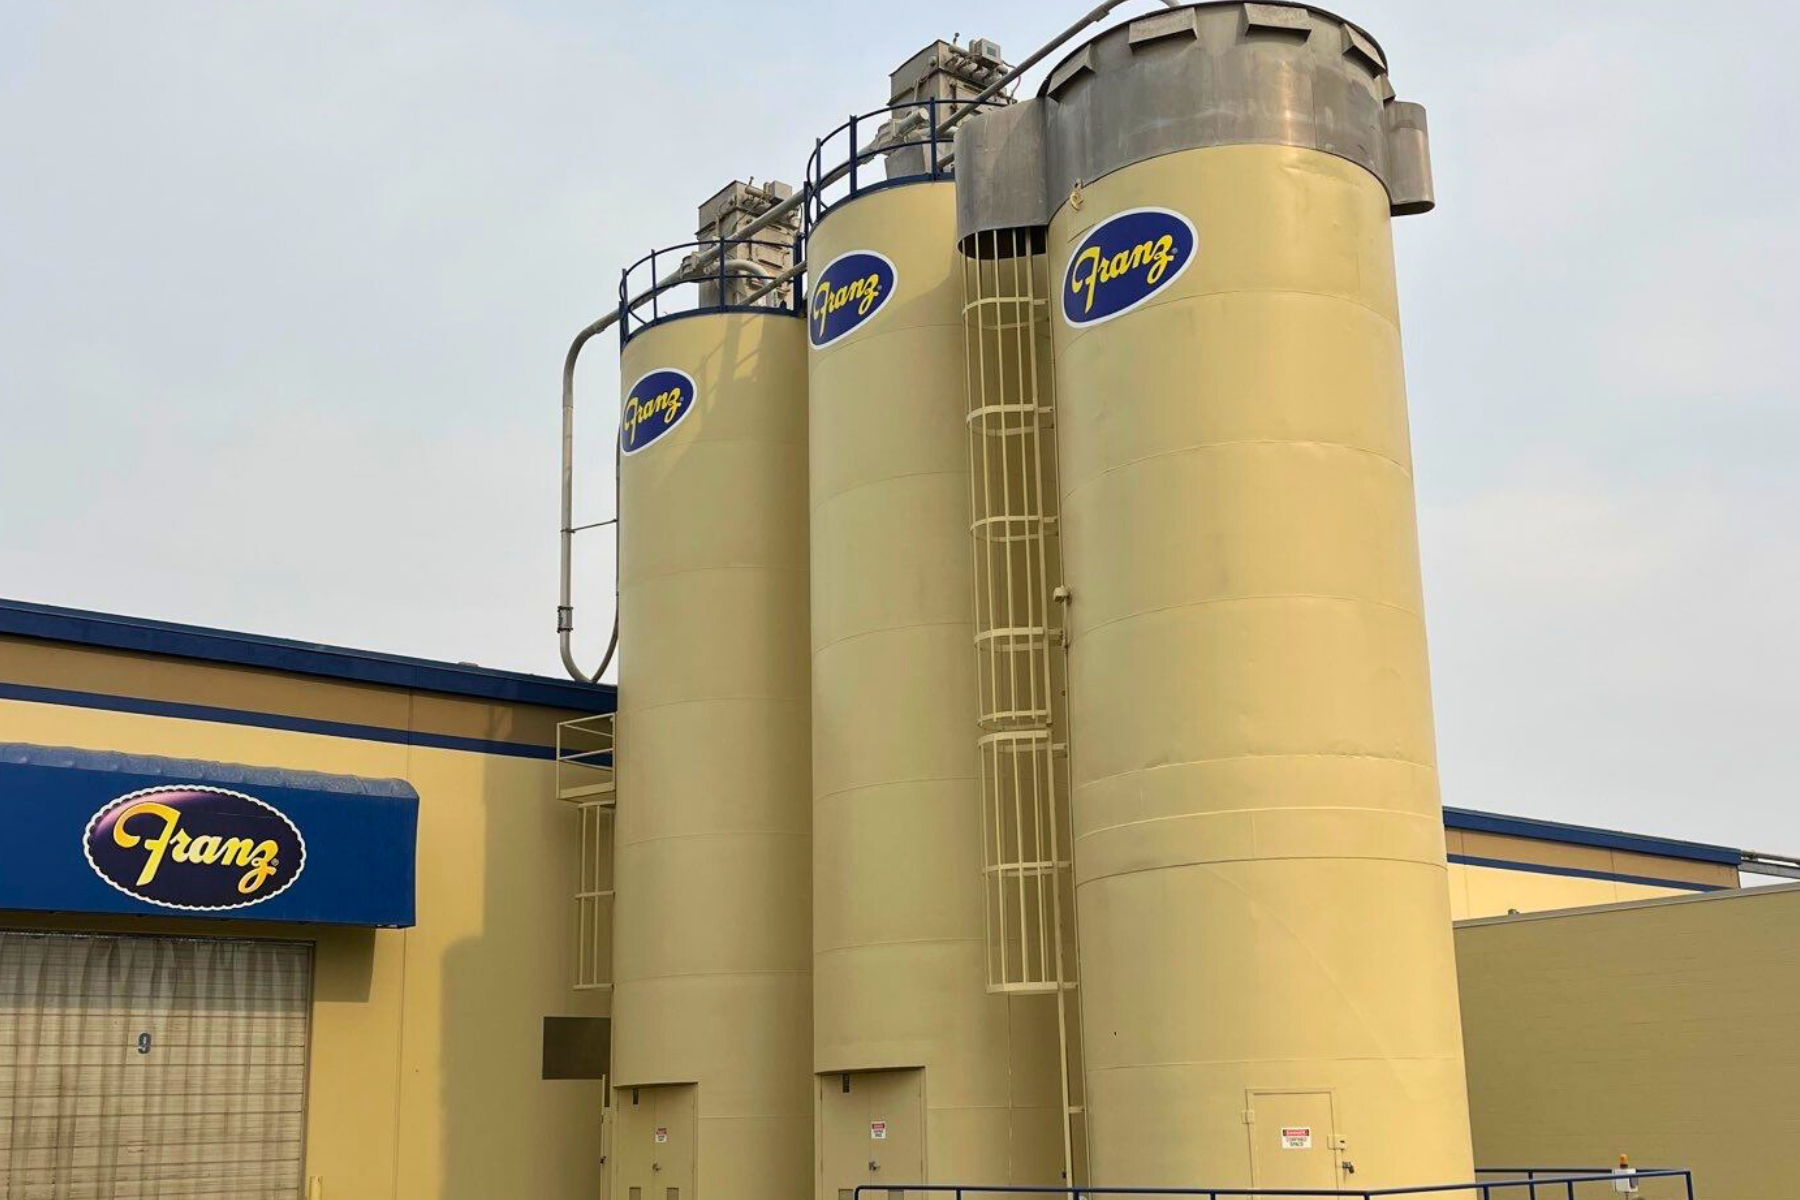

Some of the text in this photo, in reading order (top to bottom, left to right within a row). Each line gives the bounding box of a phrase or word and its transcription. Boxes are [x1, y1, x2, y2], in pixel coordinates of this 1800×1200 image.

[813, 273, 879, 338] Franz
[1071, 234, 1174, 314] Franz
[624, 387, 682, 446] Franz
[113, 801, 279, 894] Franz
[138, 1032, 151, 1054] 9
